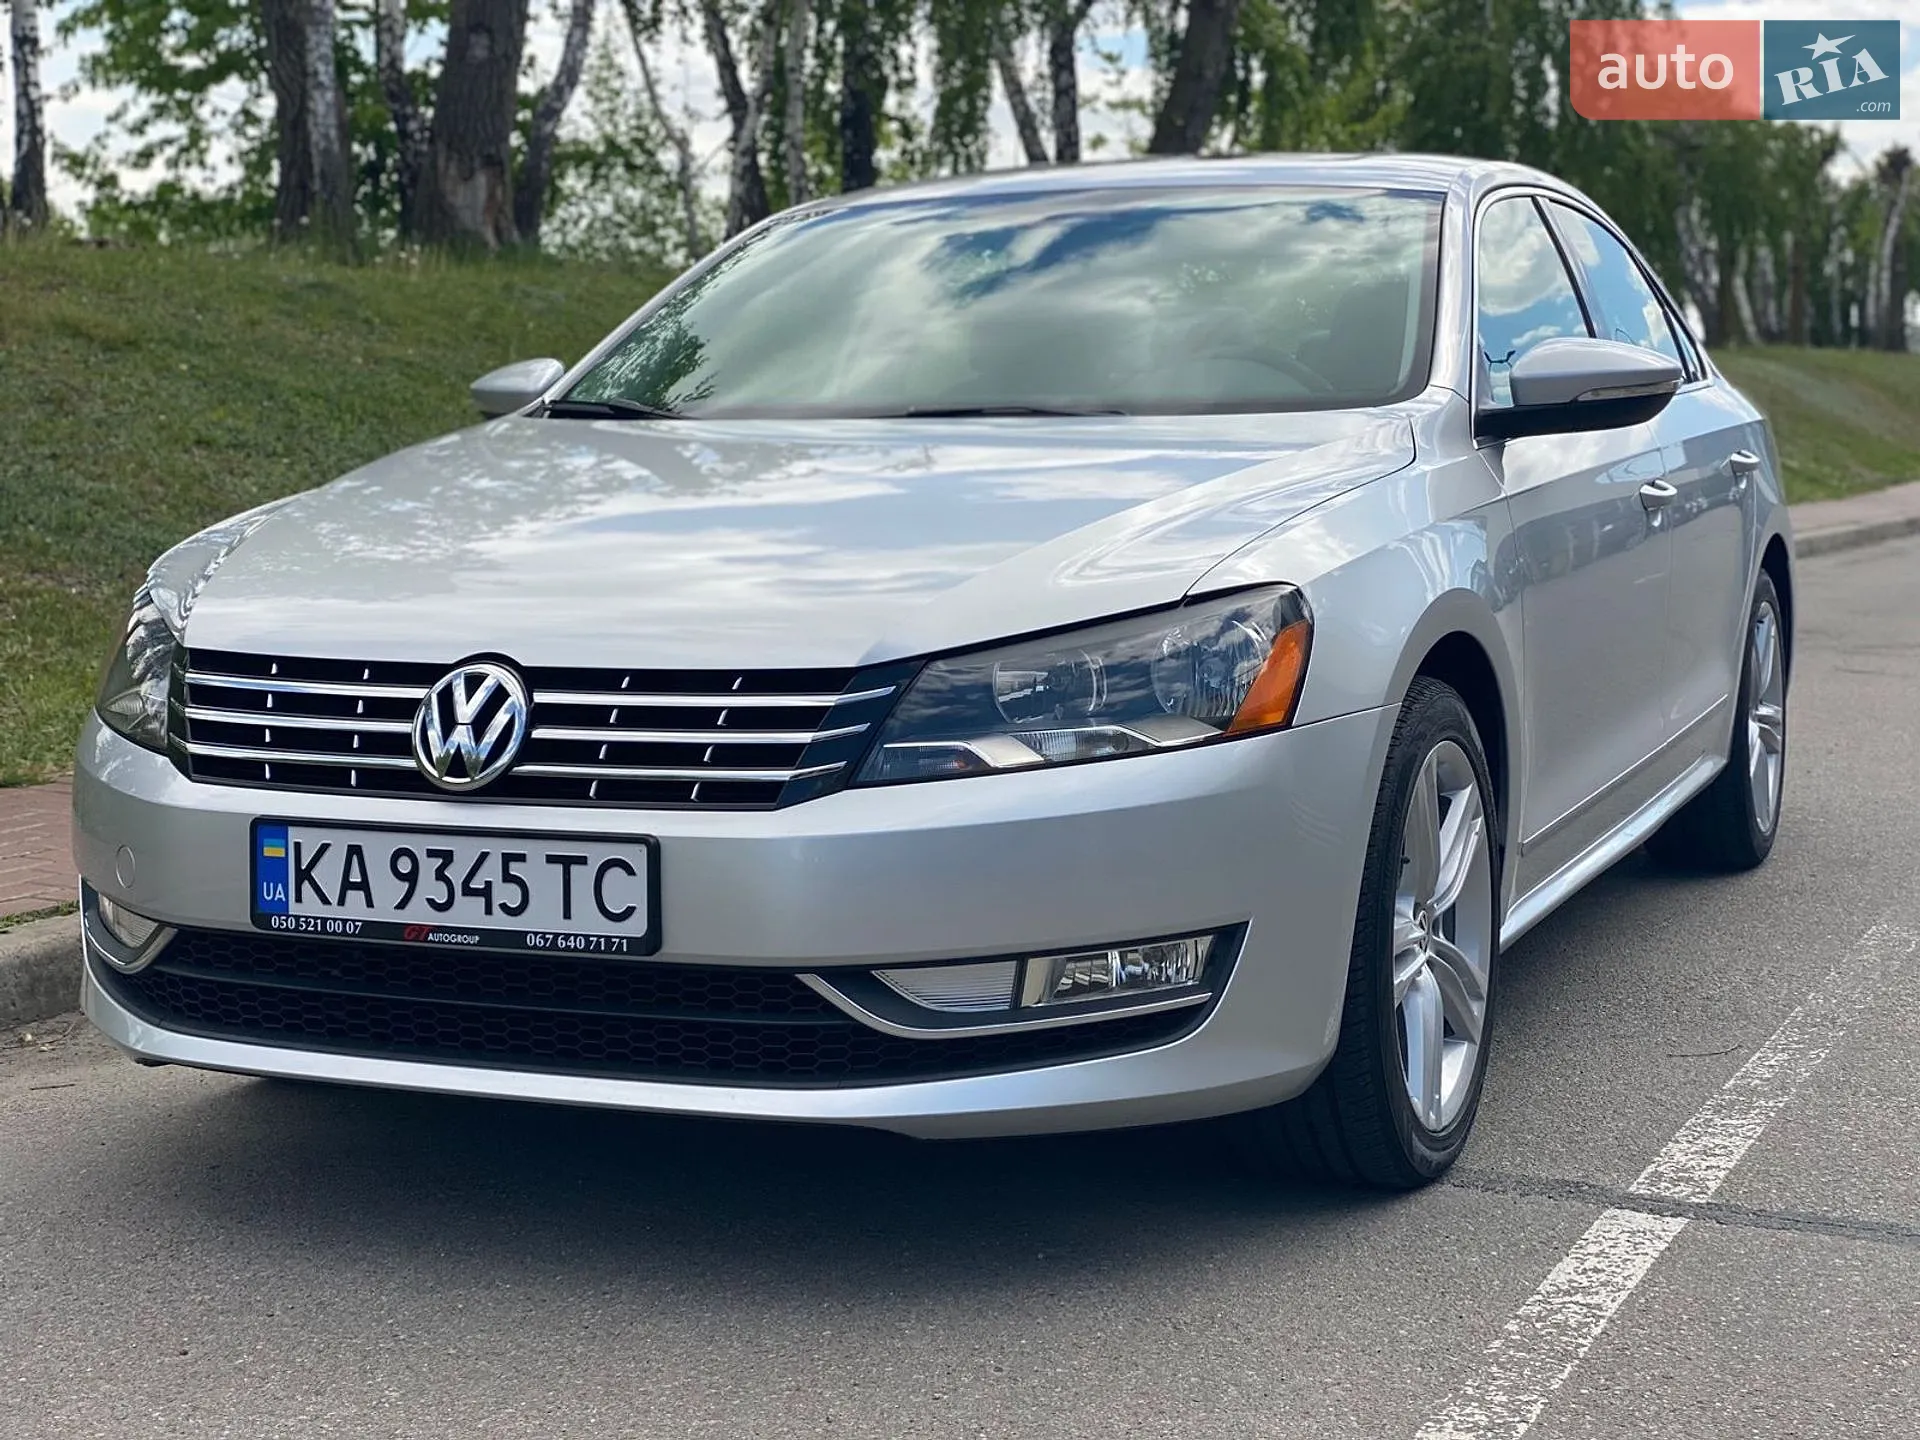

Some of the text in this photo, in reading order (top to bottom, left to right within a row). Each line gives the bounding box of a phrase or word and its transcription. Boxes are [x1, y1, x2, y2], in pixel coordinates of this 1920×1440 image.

[418, 667, 523, 786] VW
[293, 840, 638, 924] KA 9345 TC
[263, 882, 286, 902] UA
[271, 915, 363, 934] 050 521 00 07
[427, 932, 480, 945] AUTOGROUP
[526, 933, 627, 952] 067 640 71 71
